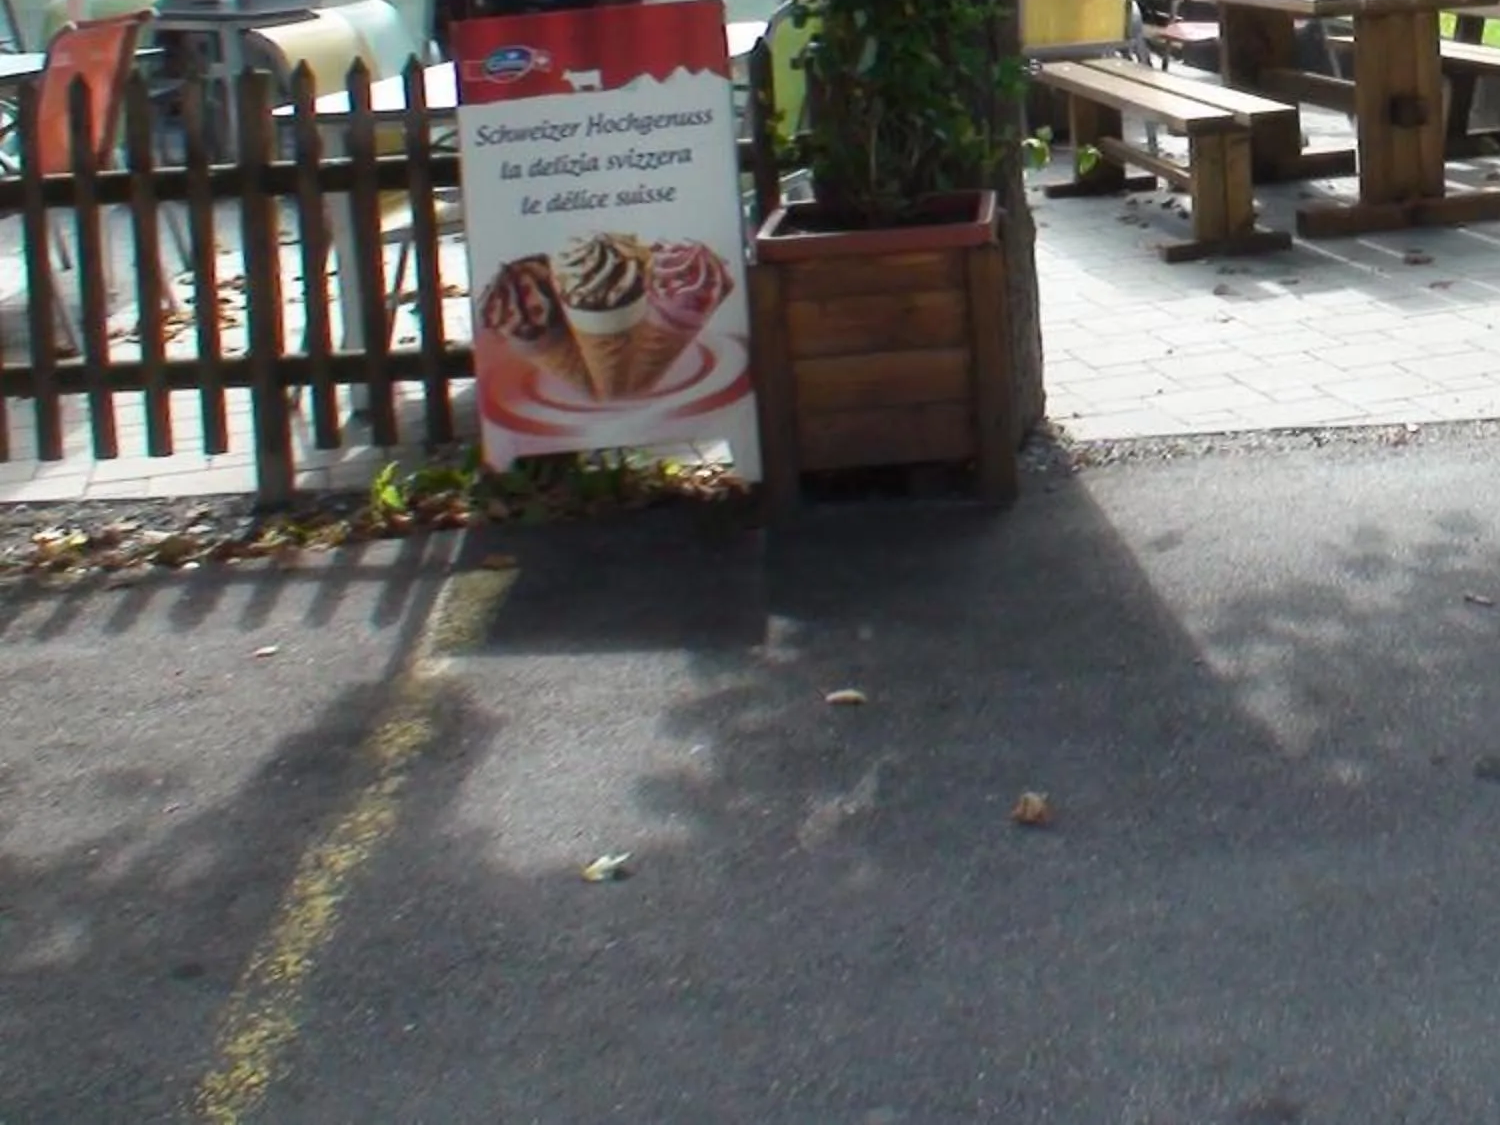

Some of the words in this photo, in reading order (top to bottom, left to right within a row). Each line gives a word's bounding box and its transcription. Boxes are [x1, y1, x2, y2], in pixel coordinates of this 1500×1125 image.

[475, 121, 581, 147] Schweizer
[585, 108, 714, 137] Hochgenuss
[499, 160, 523, 180] la
[528, 152, 601, 177] delizia
[606, 147, 694, 171] svizzera
[521, 195, 543, 215] le
[614, 183, 677, 207] suisse
